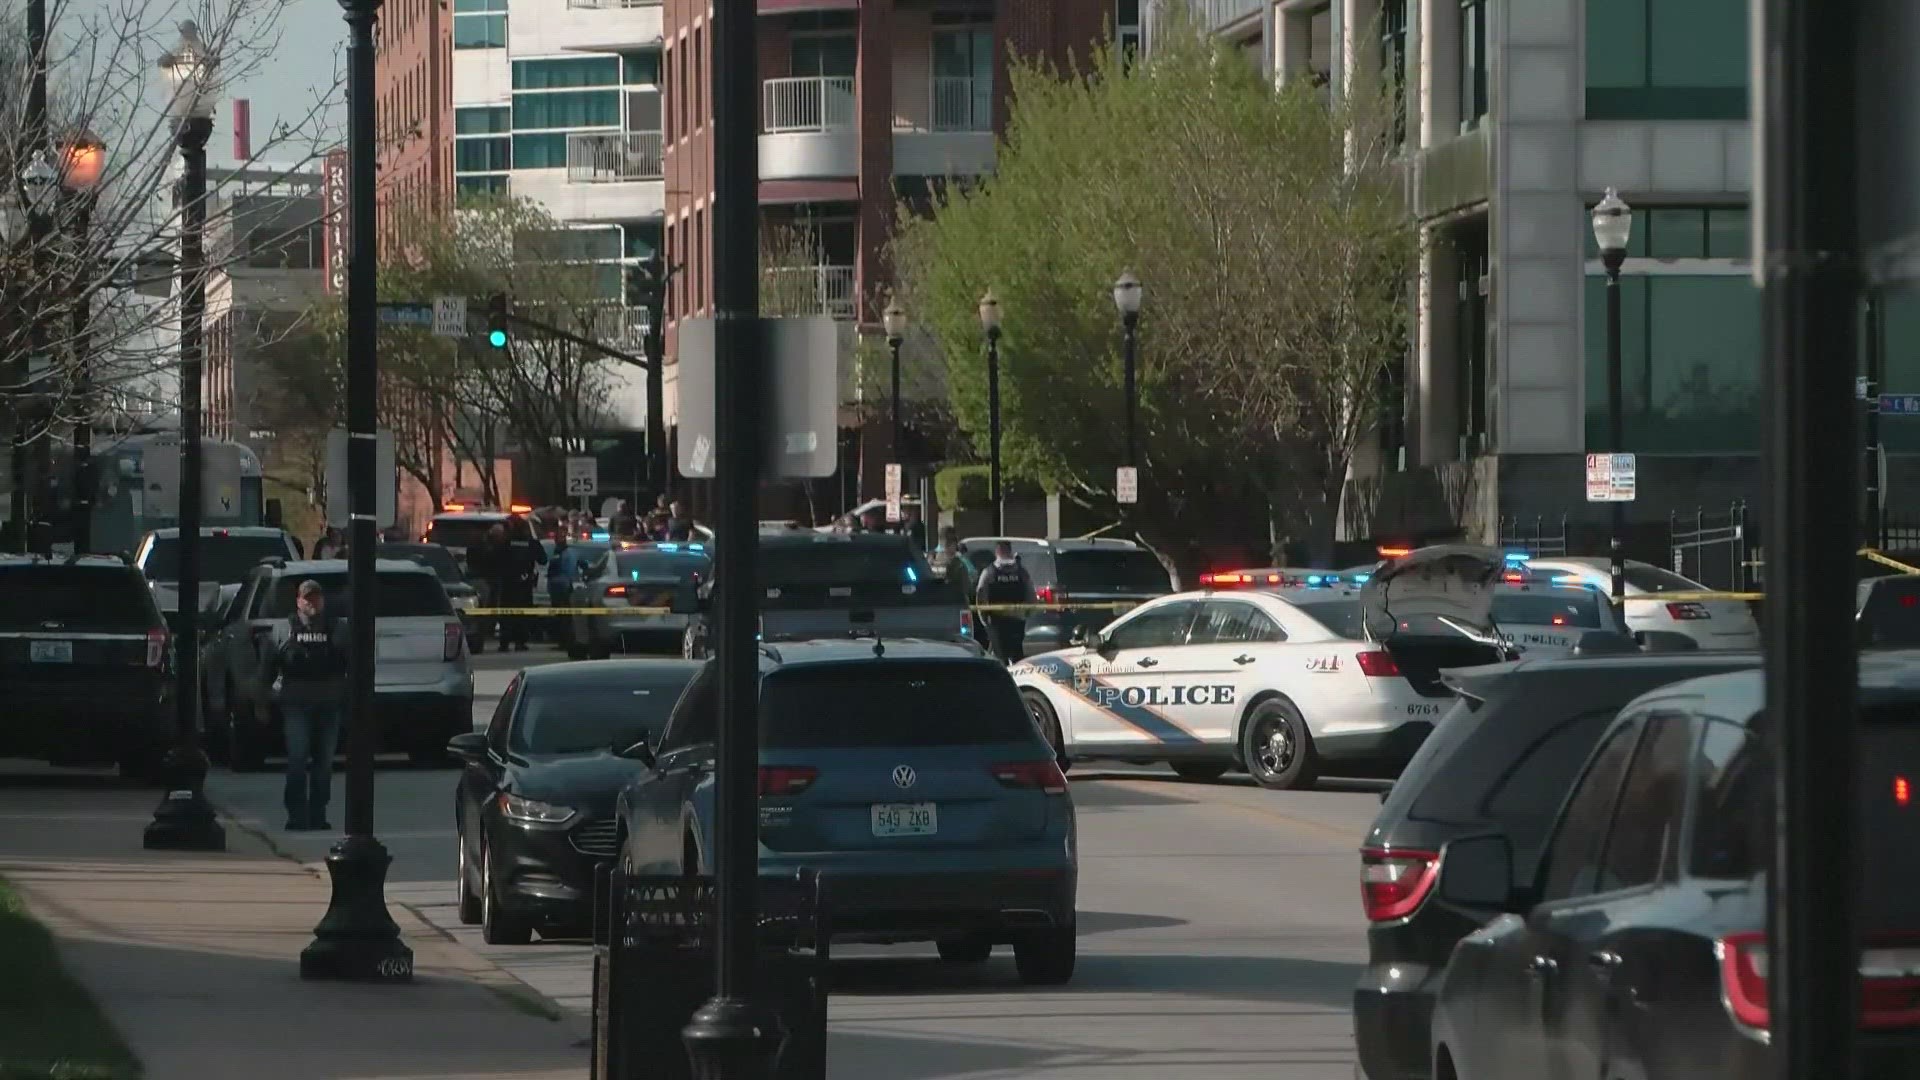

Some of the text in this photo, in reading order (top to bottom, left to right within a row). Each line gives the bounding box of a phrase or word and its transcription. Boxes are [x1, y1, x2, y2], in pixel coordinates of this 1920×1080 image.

[443, 301, 457, 310] NO
[438, 324, 462, 333] TURN
[571, 478, 593, 492] 25
[1096, 685, 1235, 708] POLICE
[1407, 704, 1439, 715] 6764
